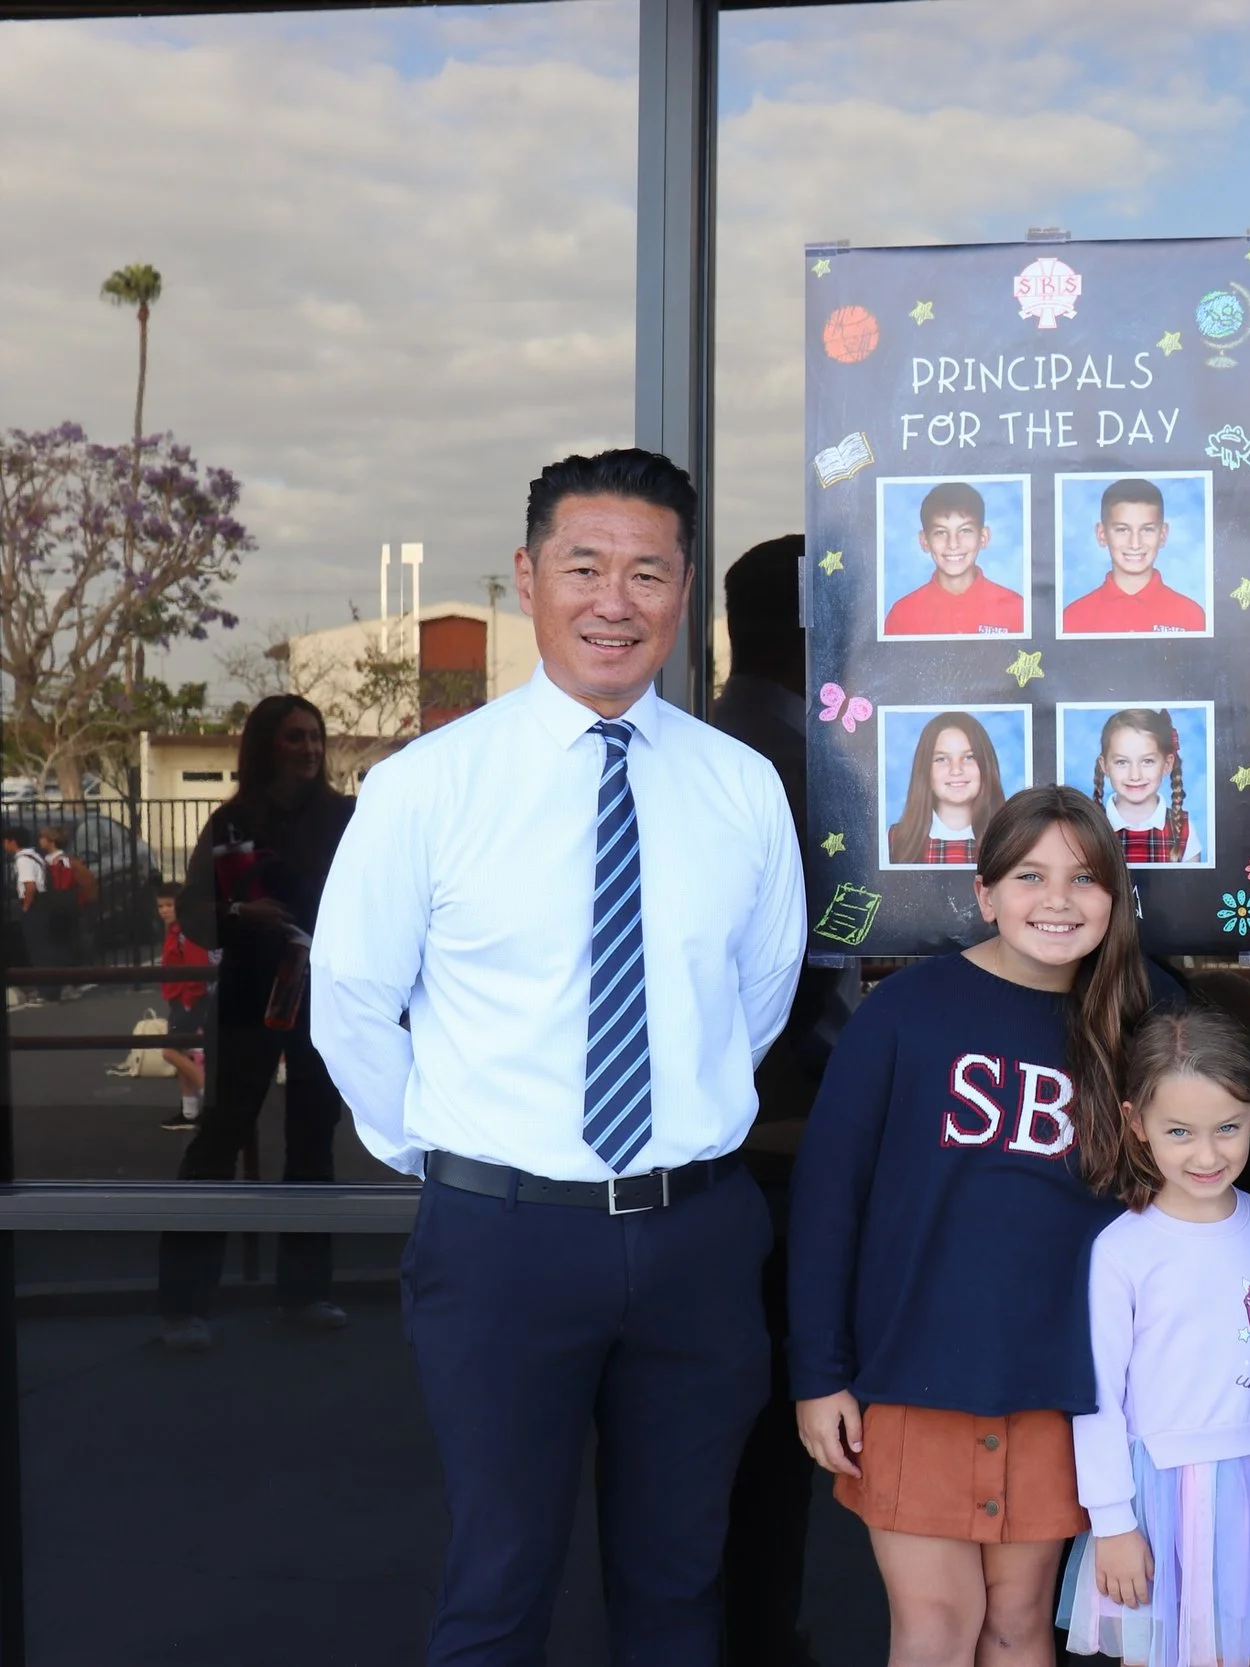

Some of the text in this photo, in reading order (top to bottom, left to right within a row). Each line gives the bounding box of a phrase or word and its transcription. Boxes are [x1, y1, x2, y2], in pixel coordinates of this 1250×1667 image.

[1019, 275, 1077, 295] SBS
[912, 352, 1153, 394] PRINCIPALS
[901, 407, 1180, 450] FOR THE DAY
